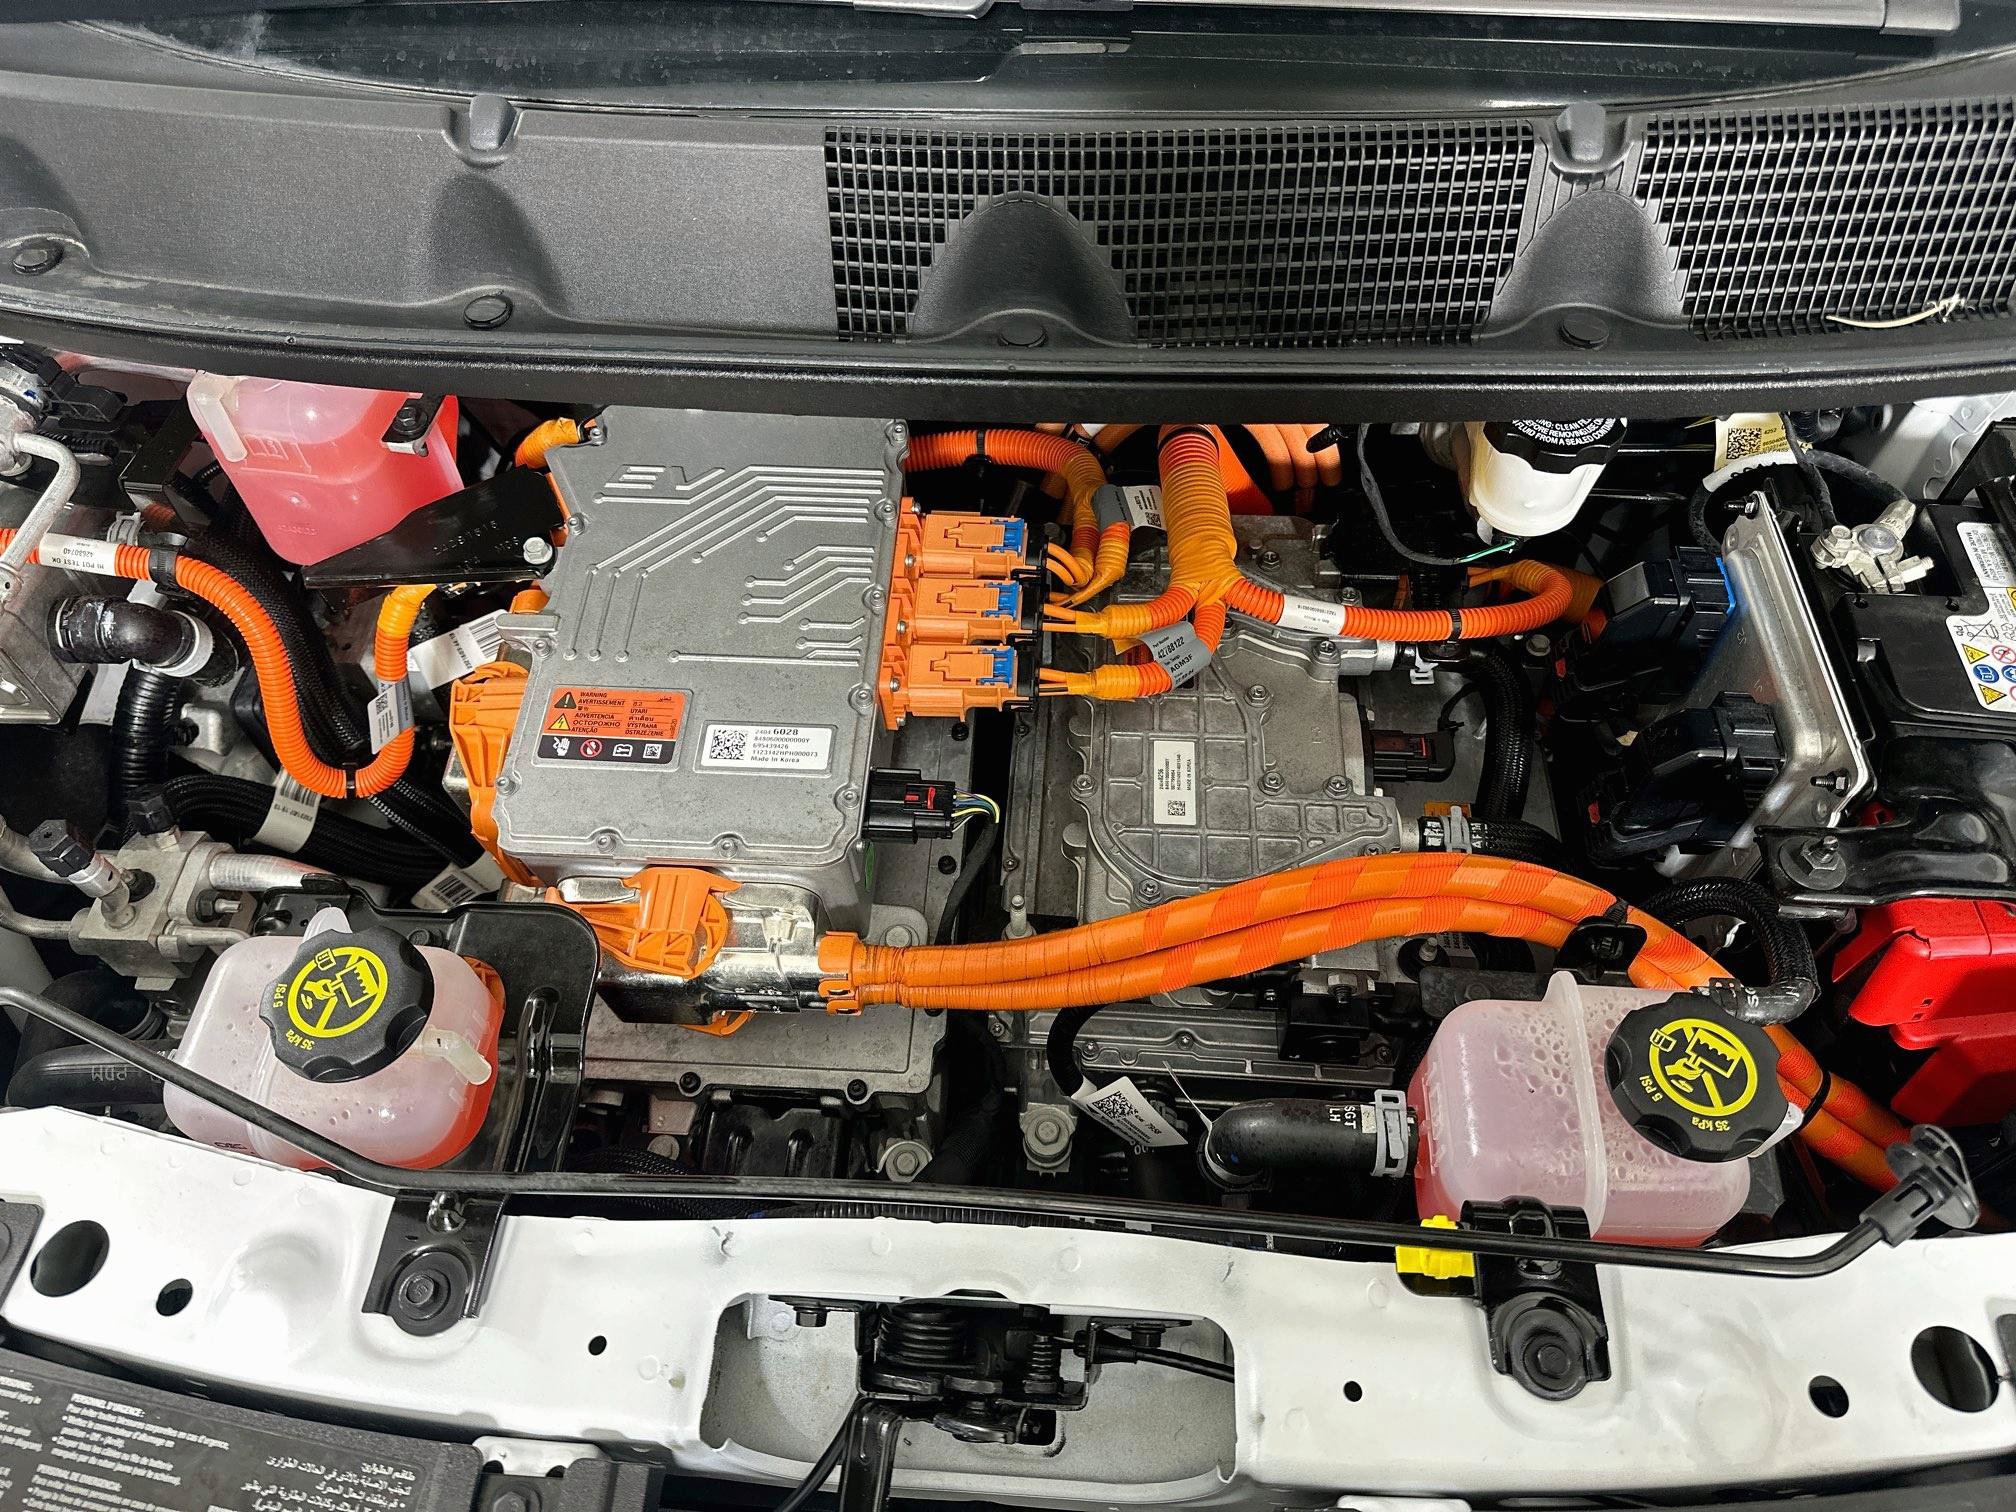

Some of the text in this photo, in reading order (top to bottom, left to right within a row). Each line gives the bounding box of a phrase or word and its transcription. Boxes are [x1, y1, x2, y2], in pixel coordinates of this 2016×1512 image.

[1515, 421, 1535, 436] FLUID
[1535, 433, 1558, 444] FROM
[1558, 438, 1565, 446] A
[1565, 434, 1595, 446] SEALED
[1555, 422, 1580, 431] CLEAN
[273, 983, 288, 999] PSI
[285, 1029, 315, 1051] 35 kPa
[1639, 1075, 1663, 1102] 5 PSI
[1329, 1108, 1341, 1122] LH
[1344, 1105, 1357, 1130] SGT
[1691, 1116, 1731, 1132] 35 kPa
